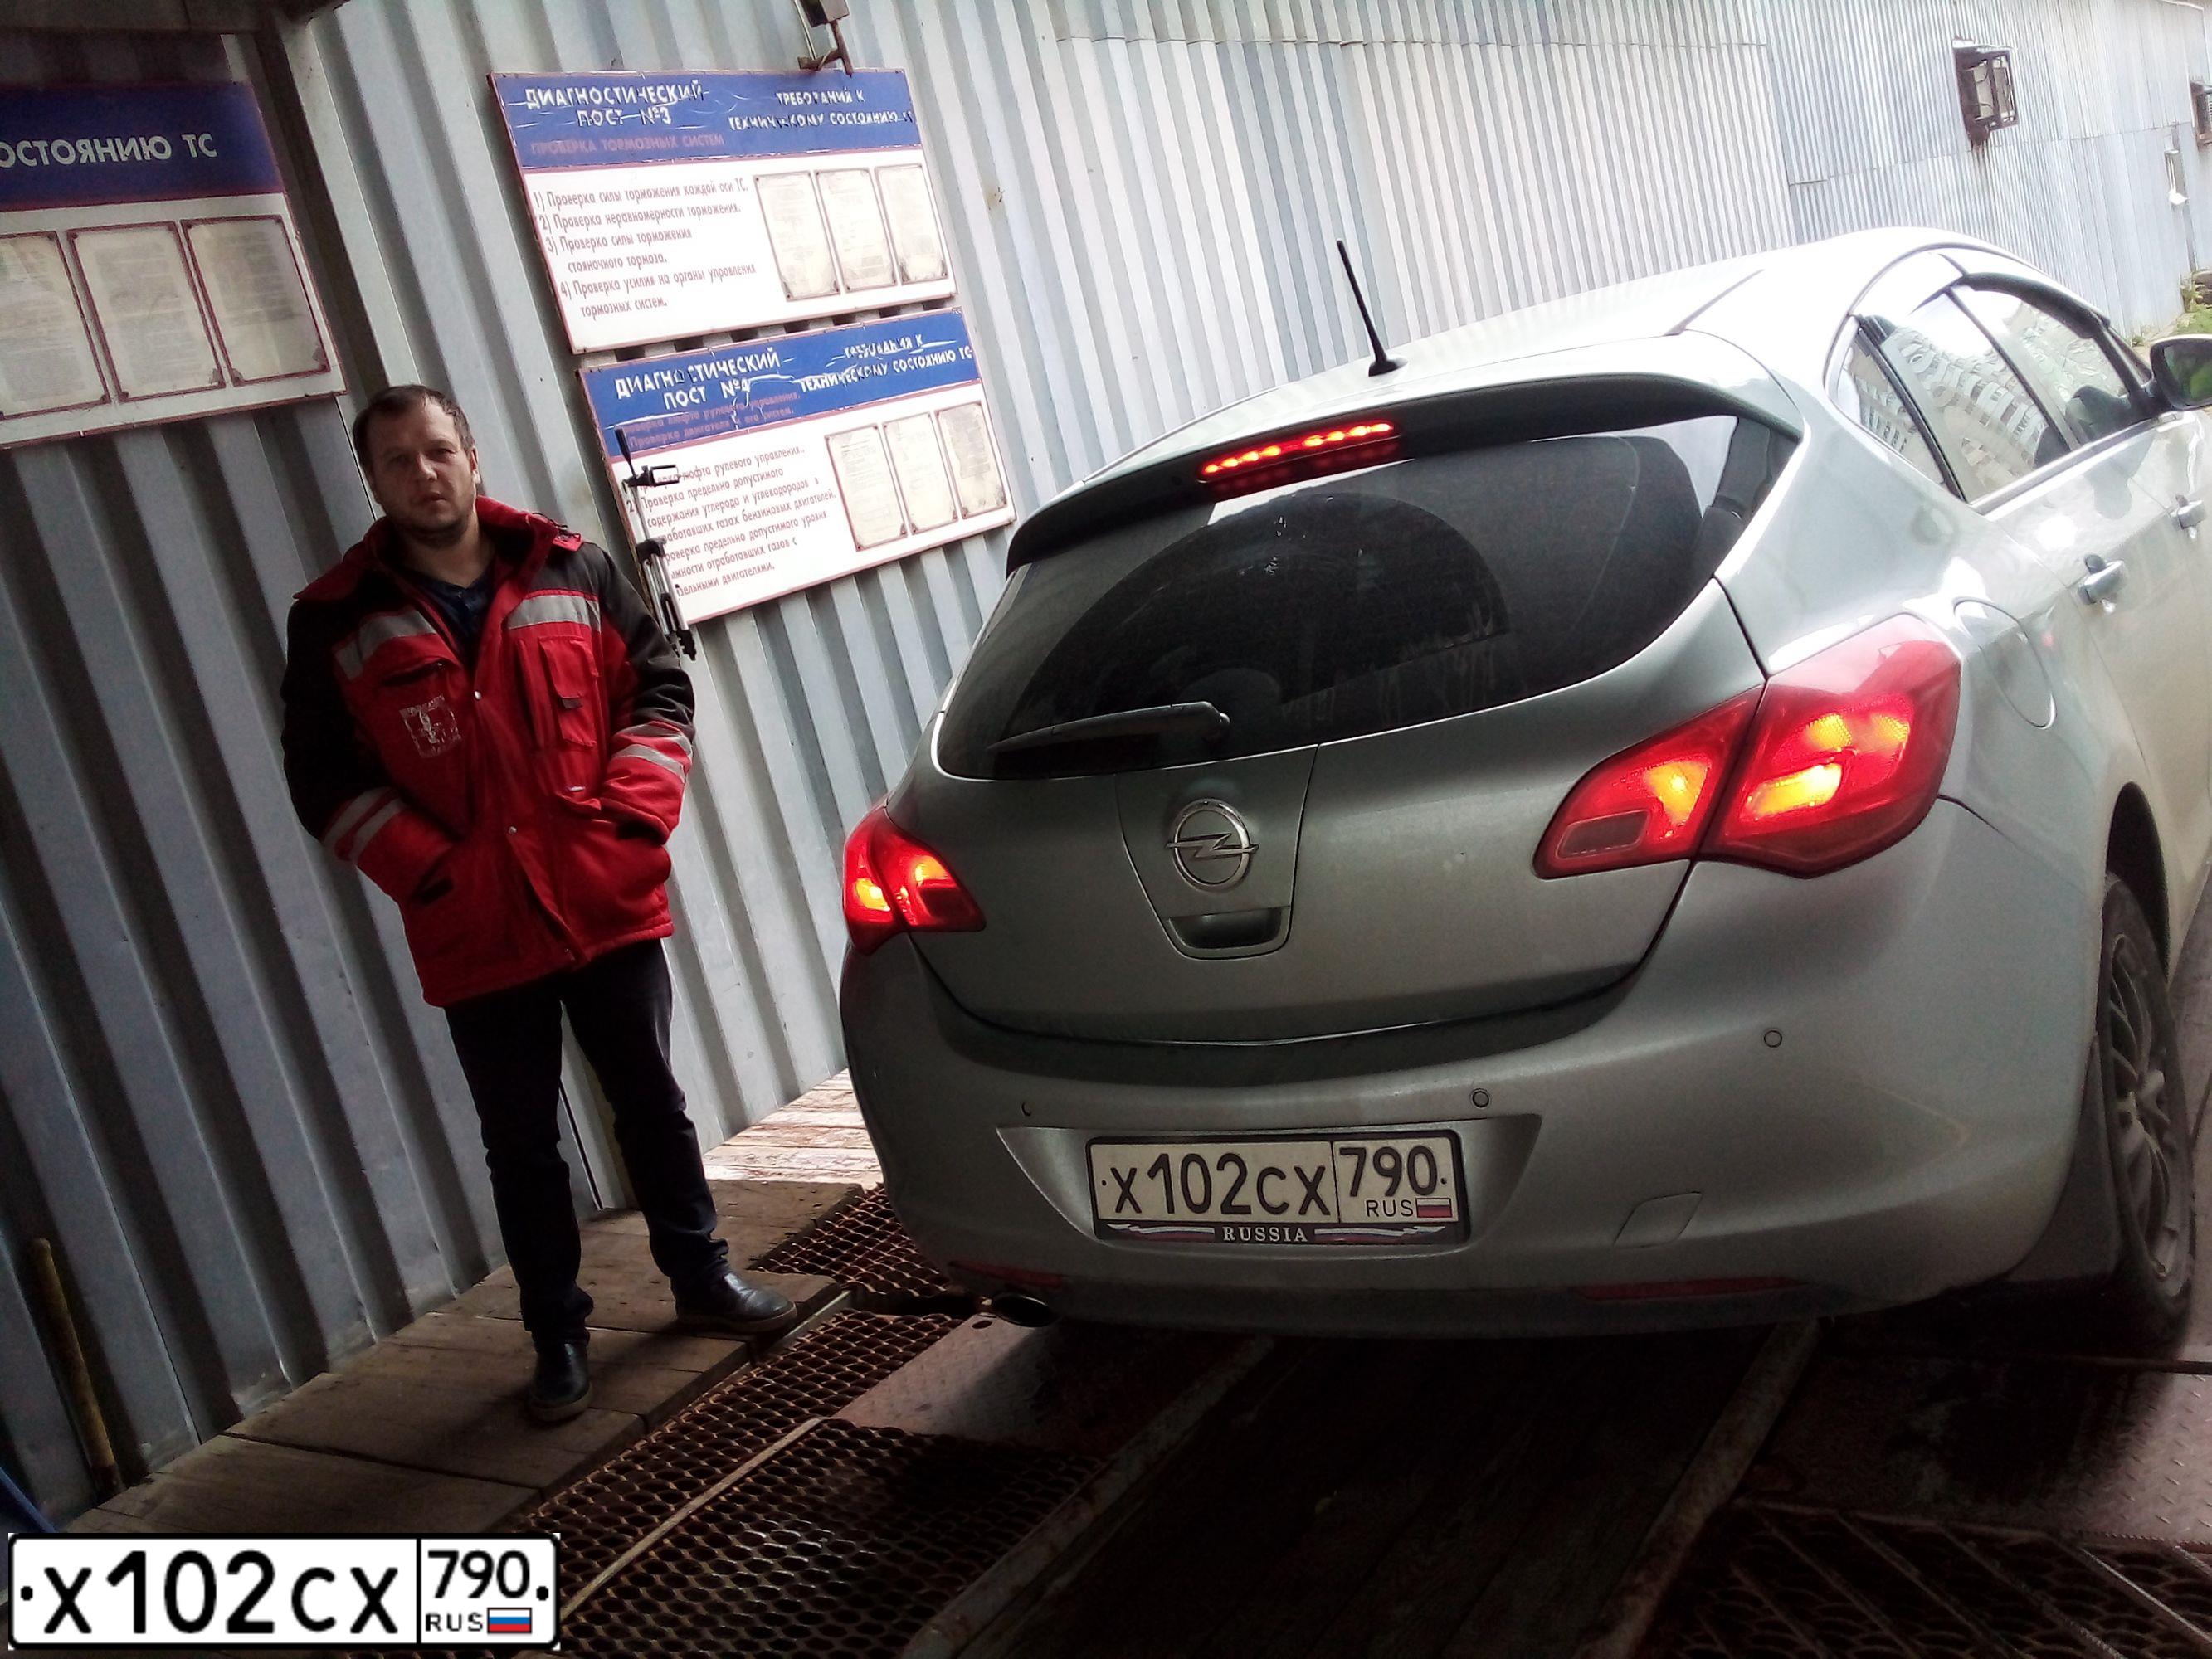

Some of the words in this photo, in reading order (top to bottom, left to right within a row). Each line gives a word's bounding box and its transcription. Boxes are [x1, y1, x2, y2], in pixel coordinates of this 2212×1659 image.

[525, 80, 704, 109] ДИАГНОСТИЧЕСКИЙ
[855, 90, 865, 102] К
[577, 108, 623, 127] ПОСТ
[182, 133, 218, 158] ТС
[530, 139, 597, 155] ПРОВЕРКА
[602, 136, 678, 153] ТОРМОЗНЫХ
[682, 134, 724, 148] СИСТЕМ
[533, 192, 545, 212] 1)
[547, 191, 596, 212] Проверка
[599, 190, 622, 203] силы
[625, 185, 680, 206] торможения
[684, 180, 717, 197] каждой
[719, 180, 733, 192] оси
[539, 214, 553, 233] 2)
[553, 213, 602, 233] Проверка
[605, 206, 685, 228] неравномерности
[687, 202, 741, 221] торможения.
[545, 236, 558, 255] 3)
[559, 235, 608, 254] Проверка
[611, 231, 634, 246] силы
[636, 228, 692, 248] торможения
[568, 255, 623, 274] стояночного
[560, 280, 572, 299] 4)
[573, 279, 621, 299] Проверка
[623, 275, 655, 294] усилия
[658, 275, 670, 285] на
[673, 270, 705, 287] органы
[708, 263, 756, 283] управления
[580, 301, 632, 320] тормозных
[915, 334, 923, 348] К
[615, 347, 781, 399] ДИАГНОСТИЧЕСКИЙ
[893, 351, 956, 372] СОСТОЯНИЮ
[663, 387, 706, 410] ПОСТ
[714, 457, 752, 477] рулевого
[688, 480, 730, 501] предельно
[733, 467, 783, 490] допустимого
[647, 507, 699, 528] содержания
[702, 497, 739, 518] углерода
[743, 494, 749, 504] и
[752, 479, 809, 505] углеводородов
[658, 522, 714, 547] работавших
[716, 514, 740, 529] газах
[742, 503, 792, 522] бензиновых
[664, 546, 701, 566] роверка
[704, 533, 746, 553] предельно
[749, 518, 798, 539] допустимого
[801, 510, 827, 528] уровня
[671, 563, 704, 580] ымности
[707, 547, 765, 572] отработавших
[768, 541, 790, 552] газов
[676, 577, 719, 597] зельными
[723, 562, 775, 585] двигателями.
[1338, 1146, 1438, 1197] 790
[1367, 1199, 1413, 1218] RUS
[1223, 1226, 1308, 1243] RUSSIA
